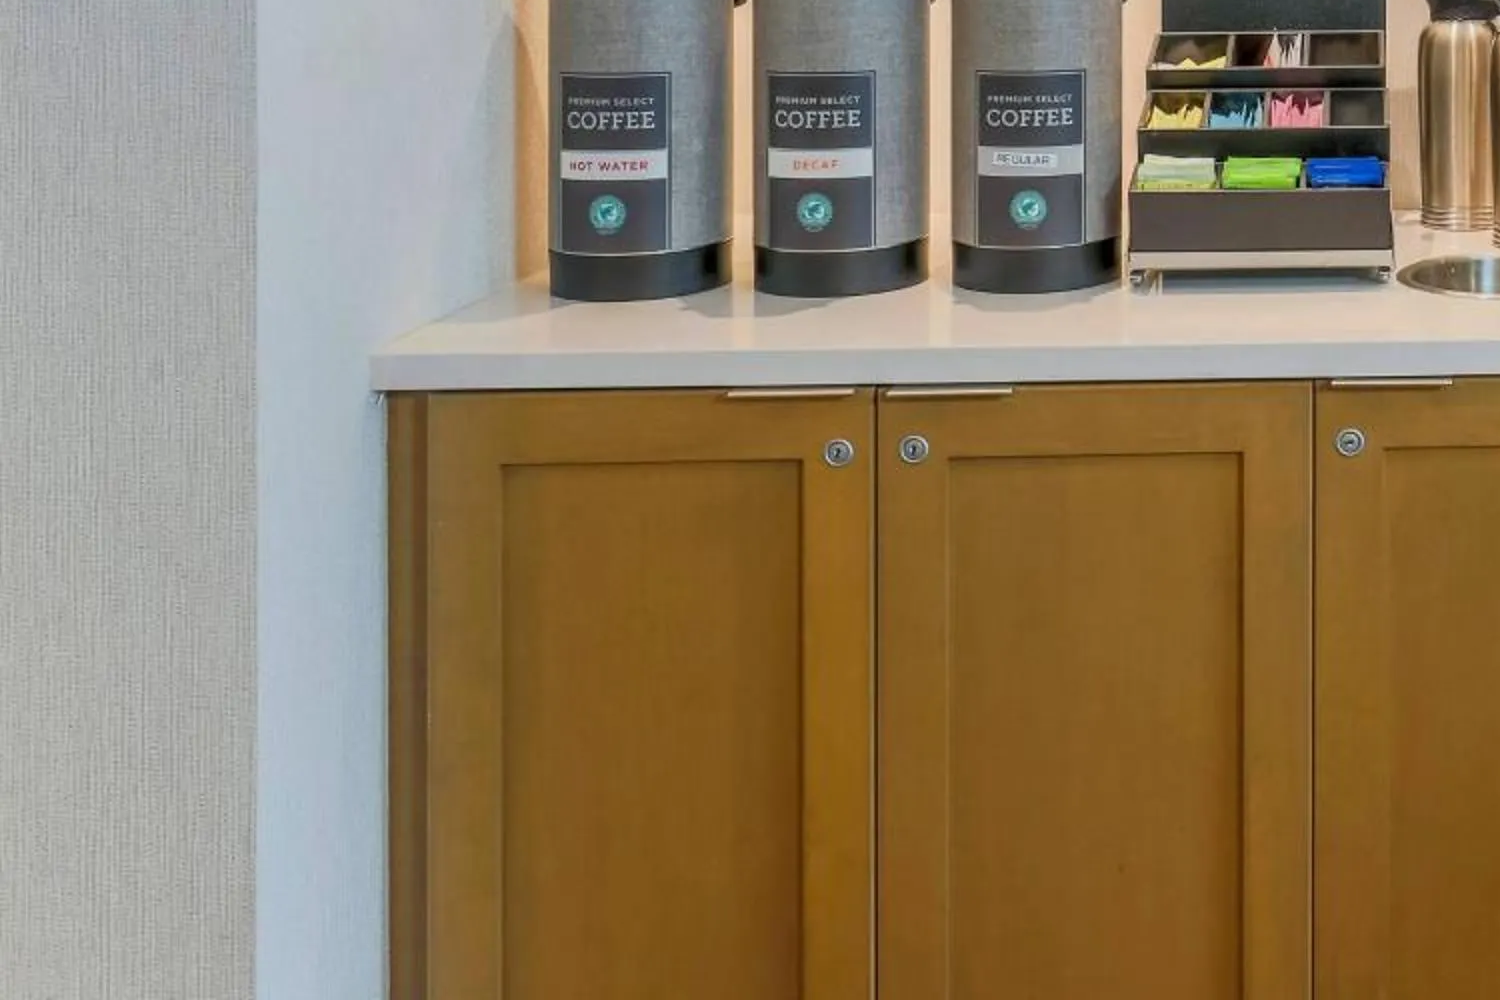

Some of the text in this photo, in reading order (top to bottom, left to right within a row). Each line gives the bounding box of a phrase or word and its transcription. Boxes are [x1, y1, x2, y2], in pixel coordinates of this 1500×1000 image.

[567, 111, 655, 130] COFFEE
[775, 109, 861, 129] COFFEE
[987, 107, 1073, 127] COFFEE
[569, 160, 650, 172] HOT WATER
[793, 159, 841, 171] DECAF
